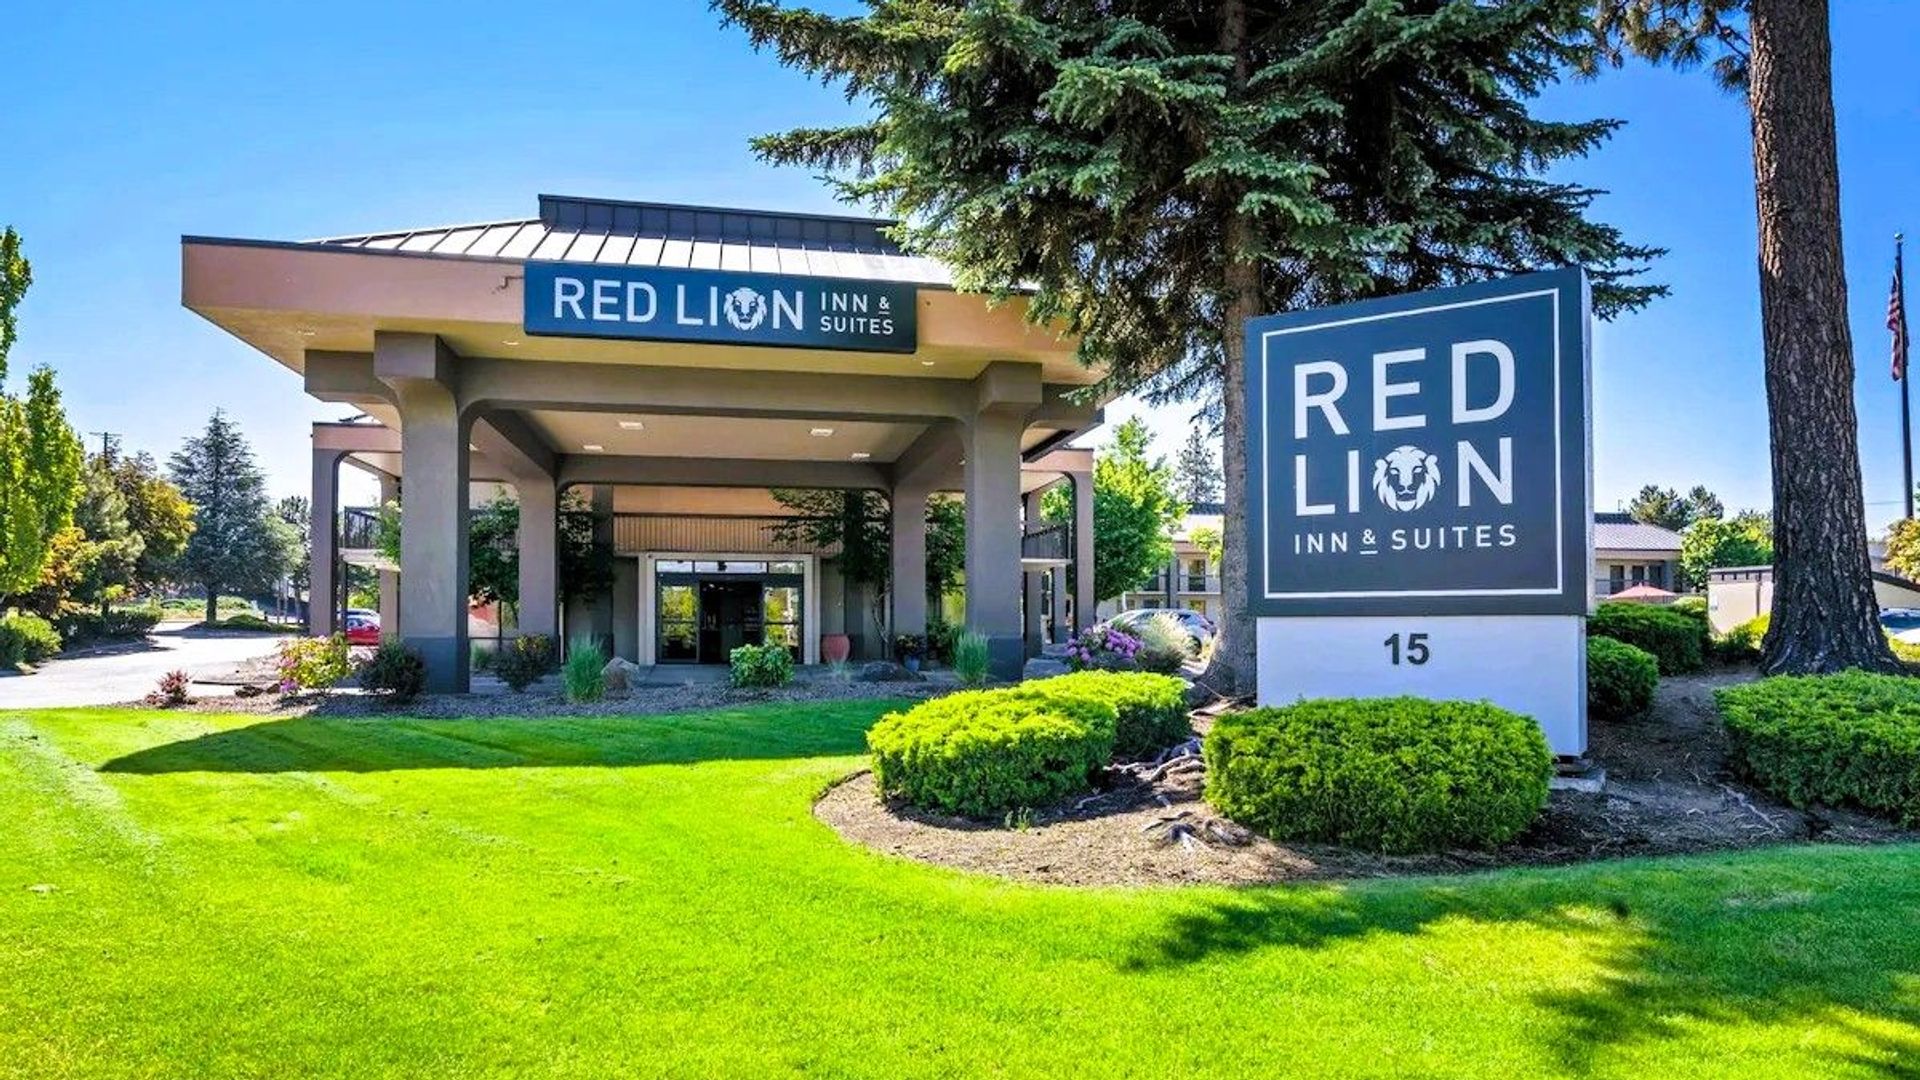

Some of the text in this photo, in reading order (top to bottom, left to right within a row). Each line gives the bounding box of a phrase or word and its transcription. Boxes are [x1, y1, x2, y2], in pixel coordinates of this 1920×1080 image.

[554, 277, 657, 323] RED
[821, 291, 890, 315] INN &
[820, 315, 894, 335] SUITES
[1294, 338, 1515, 440] RED
[1294, 524, 1516, 555] INN & SUITES
[1383, 633, 1430, 666] 15
